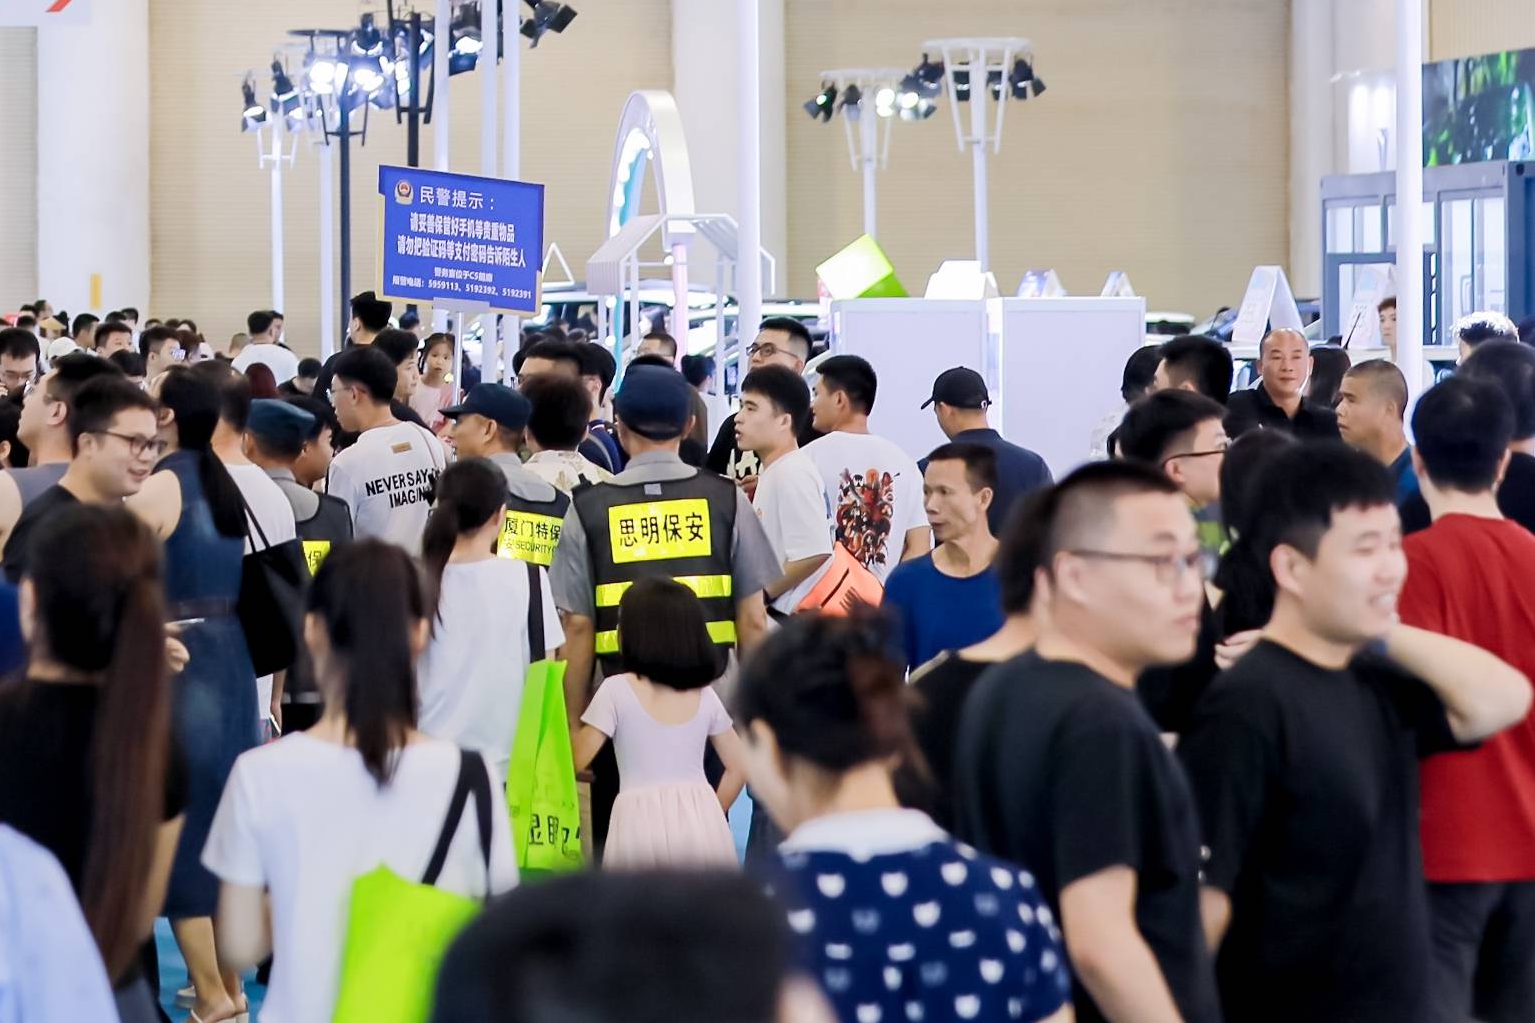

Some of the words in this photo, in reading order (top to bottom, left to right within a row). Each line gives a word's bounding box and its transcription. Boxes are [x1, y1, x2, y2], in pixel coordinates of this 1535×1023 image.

[420, 186, 494, 210] 民警提示：
[410, 212, 515, 243] 请妥善保管好手机等贵重物品
[397, 235, 526, 268] 请勿把验证码等支付密码告诉陌生人
[365, 473, 406, 496] NEVER
[407, 468, 428, 486] SAY
[504, 517, 561, 542] 厦门特保
[619, 512, 704, 547] 思明保安
[516, 540, 552, 554] SECURITY
